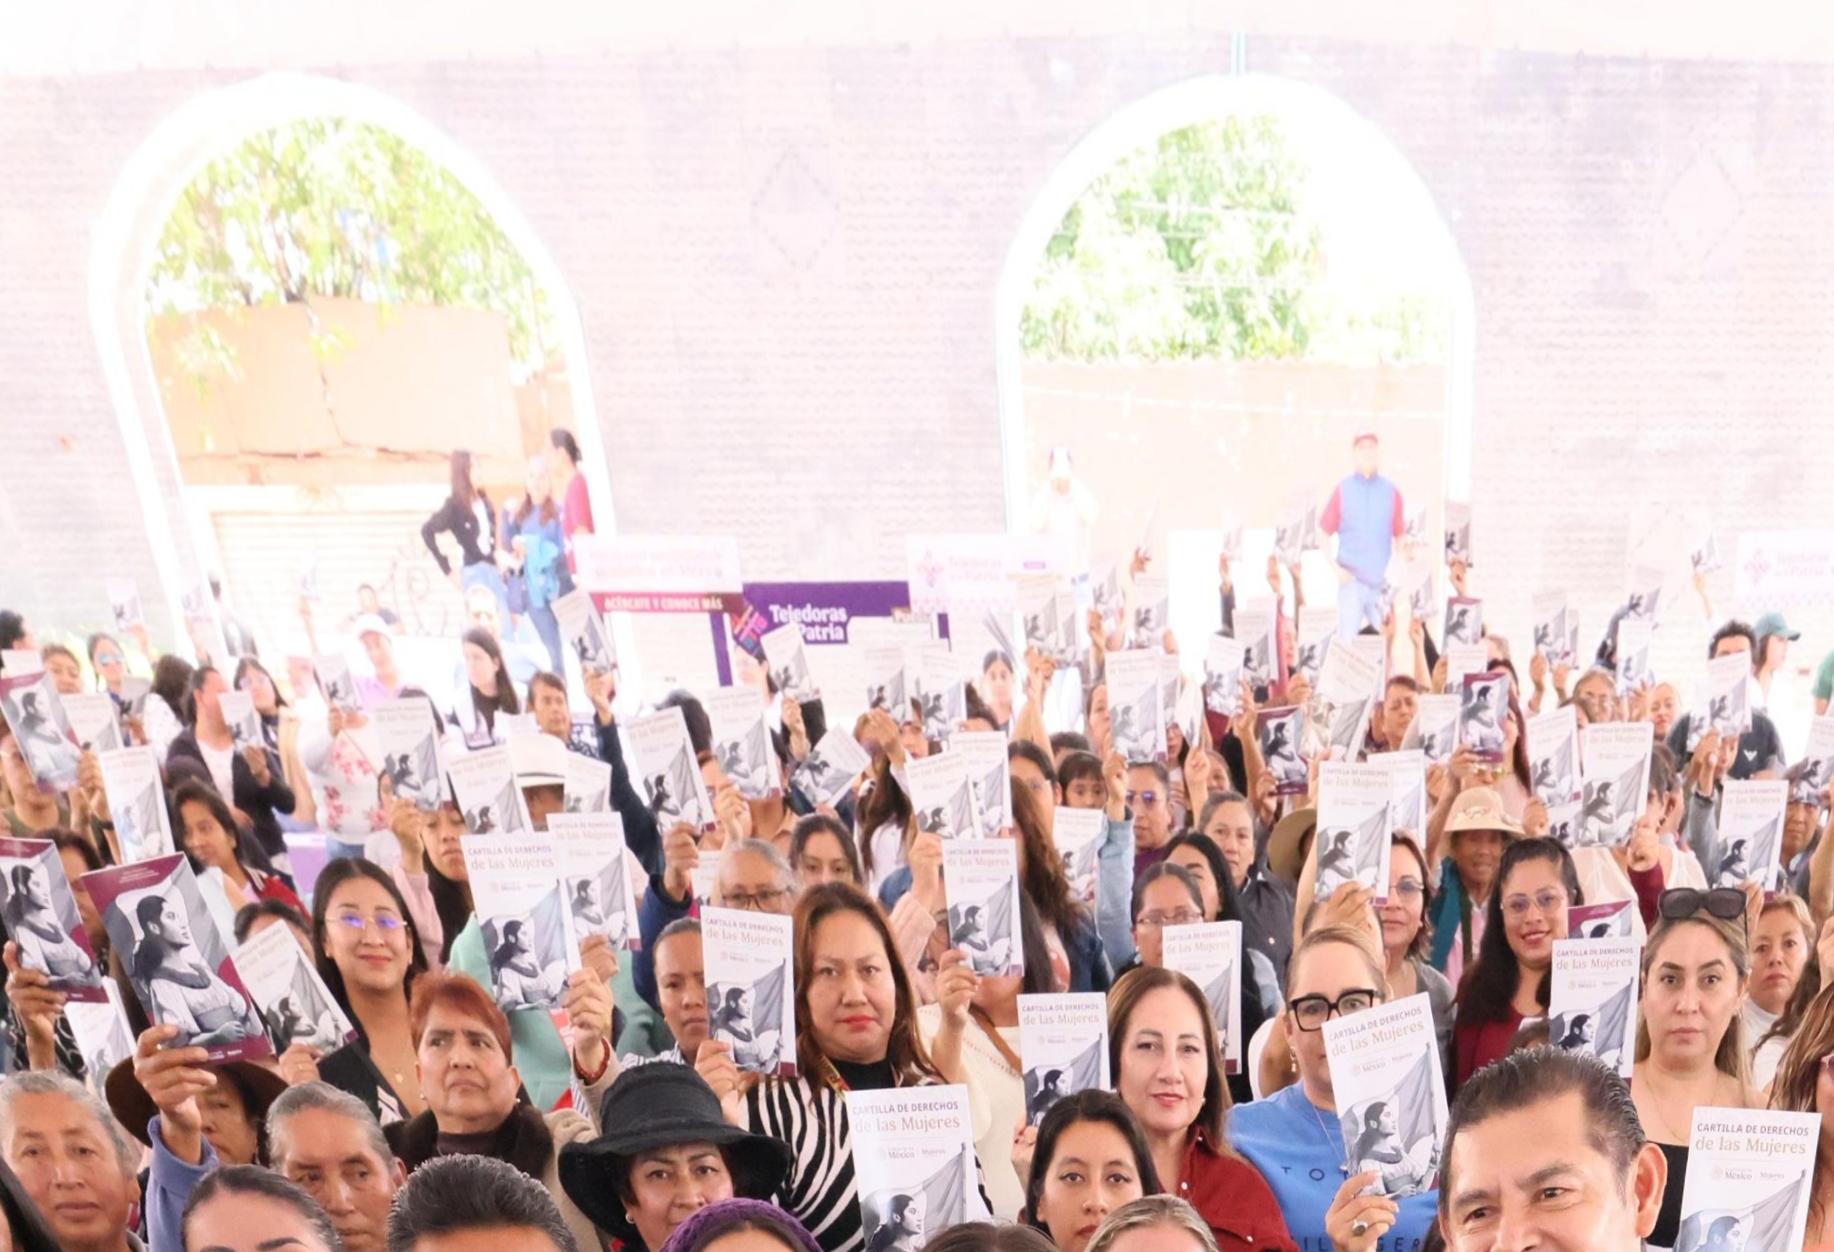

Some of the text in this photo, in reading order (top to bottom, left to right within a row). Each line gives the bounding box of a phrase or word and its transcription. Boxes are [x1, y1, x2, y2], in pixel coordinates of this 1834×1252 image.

[769, 603, 848, 623] Tejedoras
[1328, 1007, 1422, 1041] CARTILLA DE DERECHOS
[1331, 1021, 1425, 1057] de las Mujeres
[897, 1104, 908, 1113] DE
[911, 1101, 958, 1112] DERECHOS
[855, 1115, 960, 1133] de las Mujeres
[1697, 1123, 1809, 1136] CARTILLA DE DERECHOS
[1695, 1136, 1806, 1157] de las Mujeres
